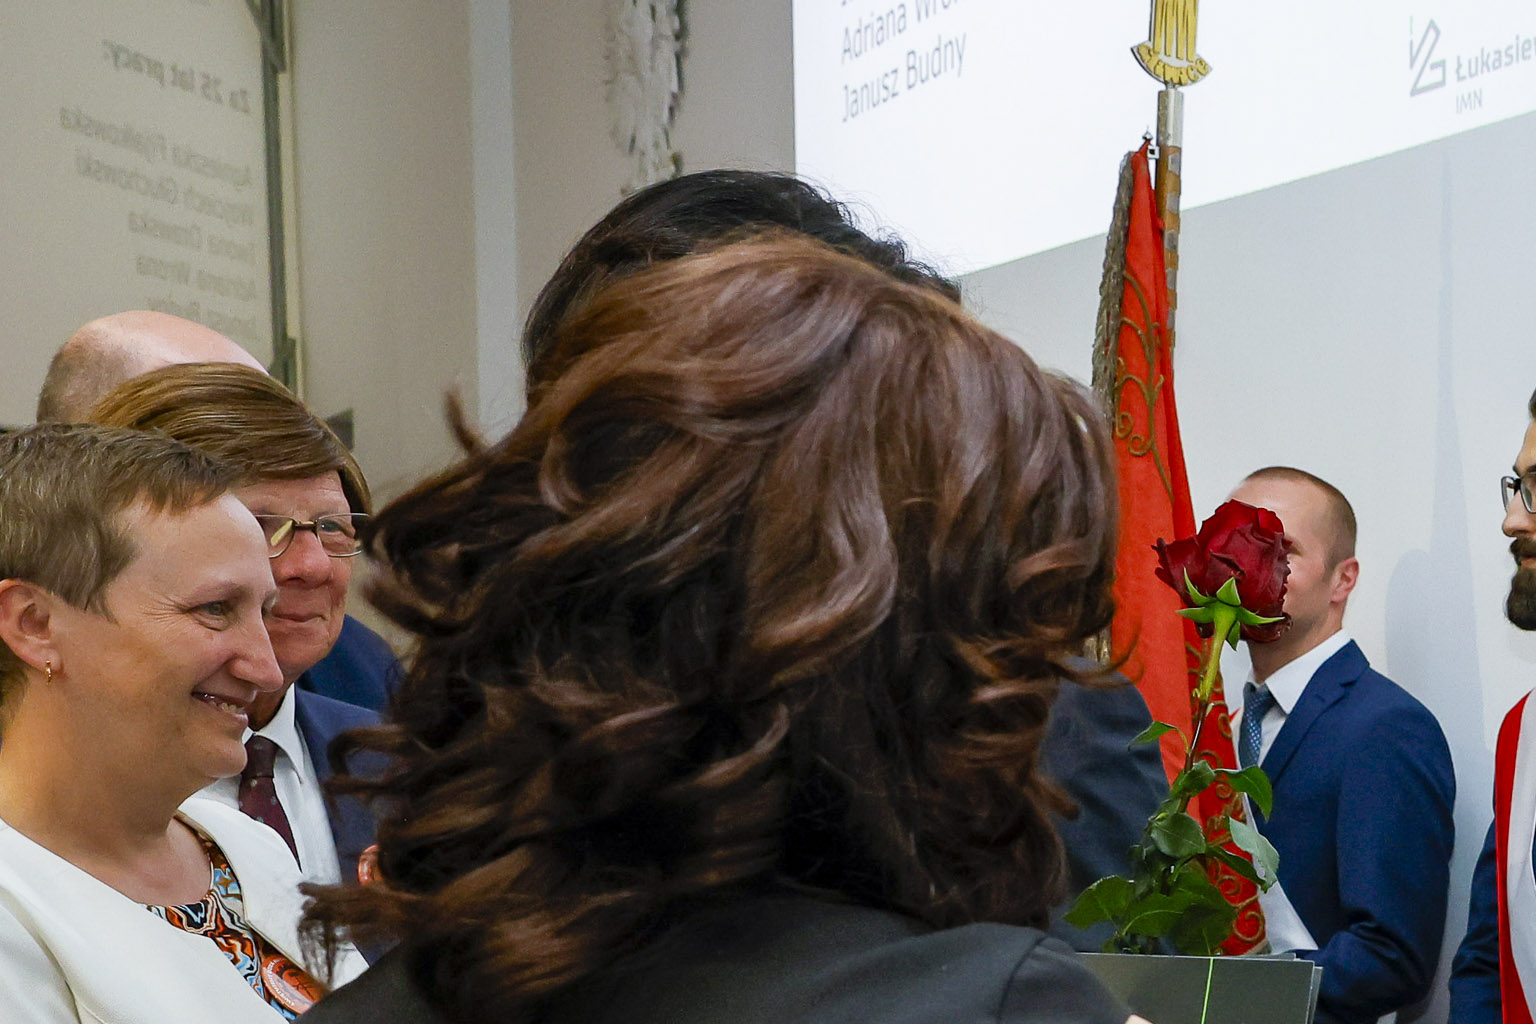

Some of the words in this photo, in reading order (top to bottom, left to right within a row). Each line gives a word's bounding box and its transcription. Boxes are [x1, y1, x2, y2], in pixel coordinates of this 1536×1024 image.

[841, 3, 906, 65] Adriana
[842, 68, 899, 123] Janusz
[906, 33, 966, 90] Budny
[1455, 88, 1483, 114] IMN
